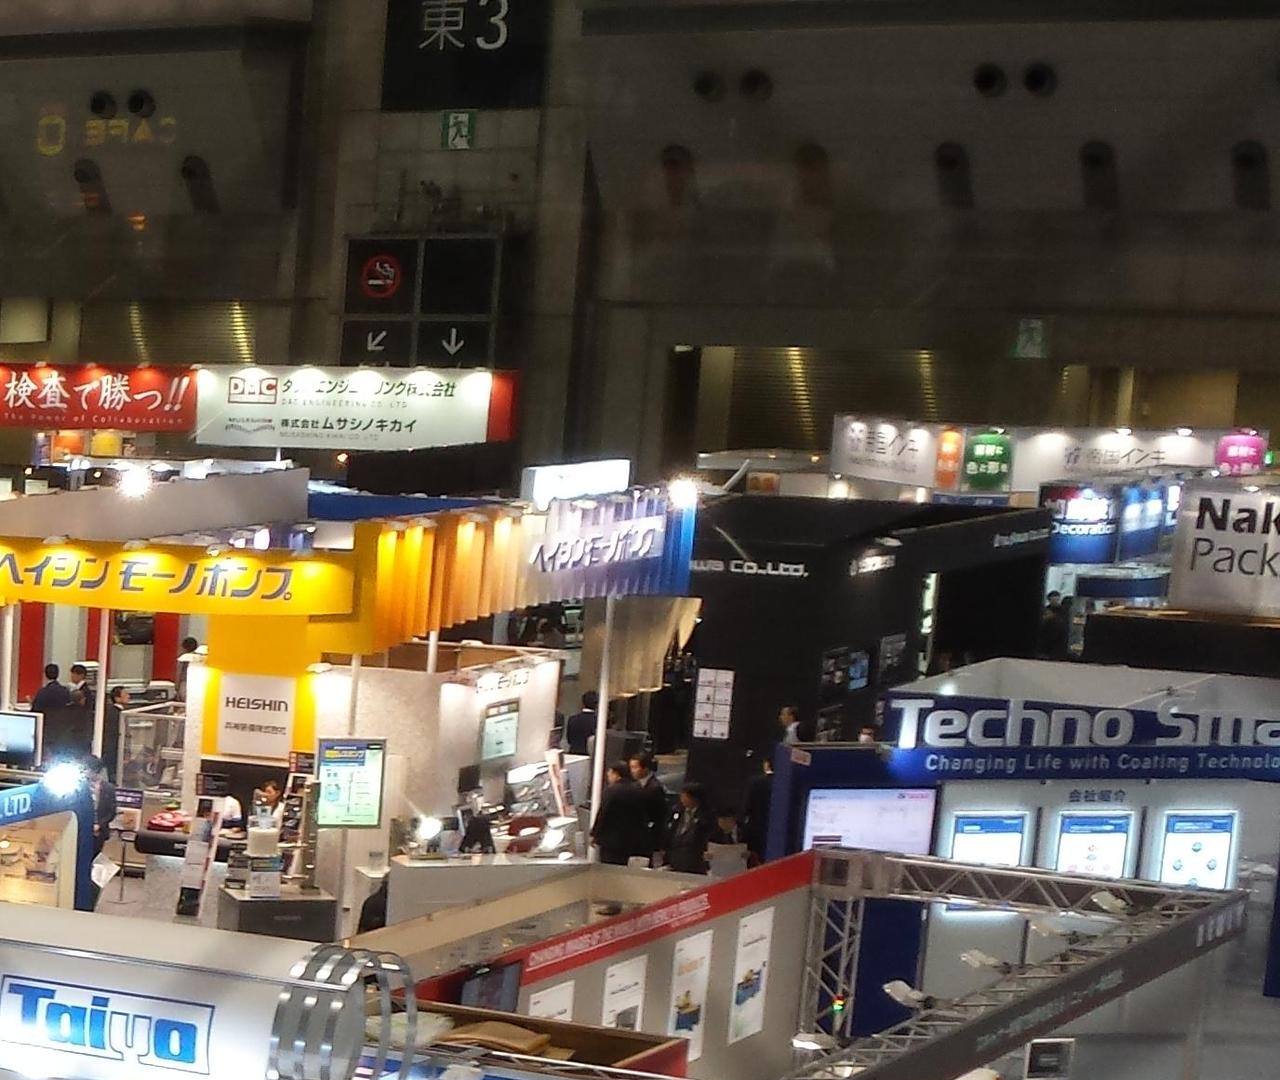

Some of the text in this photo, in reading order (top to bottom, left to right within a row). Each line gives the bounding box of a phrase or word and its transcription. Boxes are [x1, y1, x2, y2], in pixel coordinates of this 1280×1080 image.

[225, 696, 289, 713] HEISHIN
[889, 698, 1134, 750] Techno
[925, 754, 1018, 775] Changing
[1024, 754, 1063, 770] Life
[1070, 754, 1110, 770] with
[1117, 753, 1189, 774] Coating
[8, 981, 198, 1064] Taiyo
